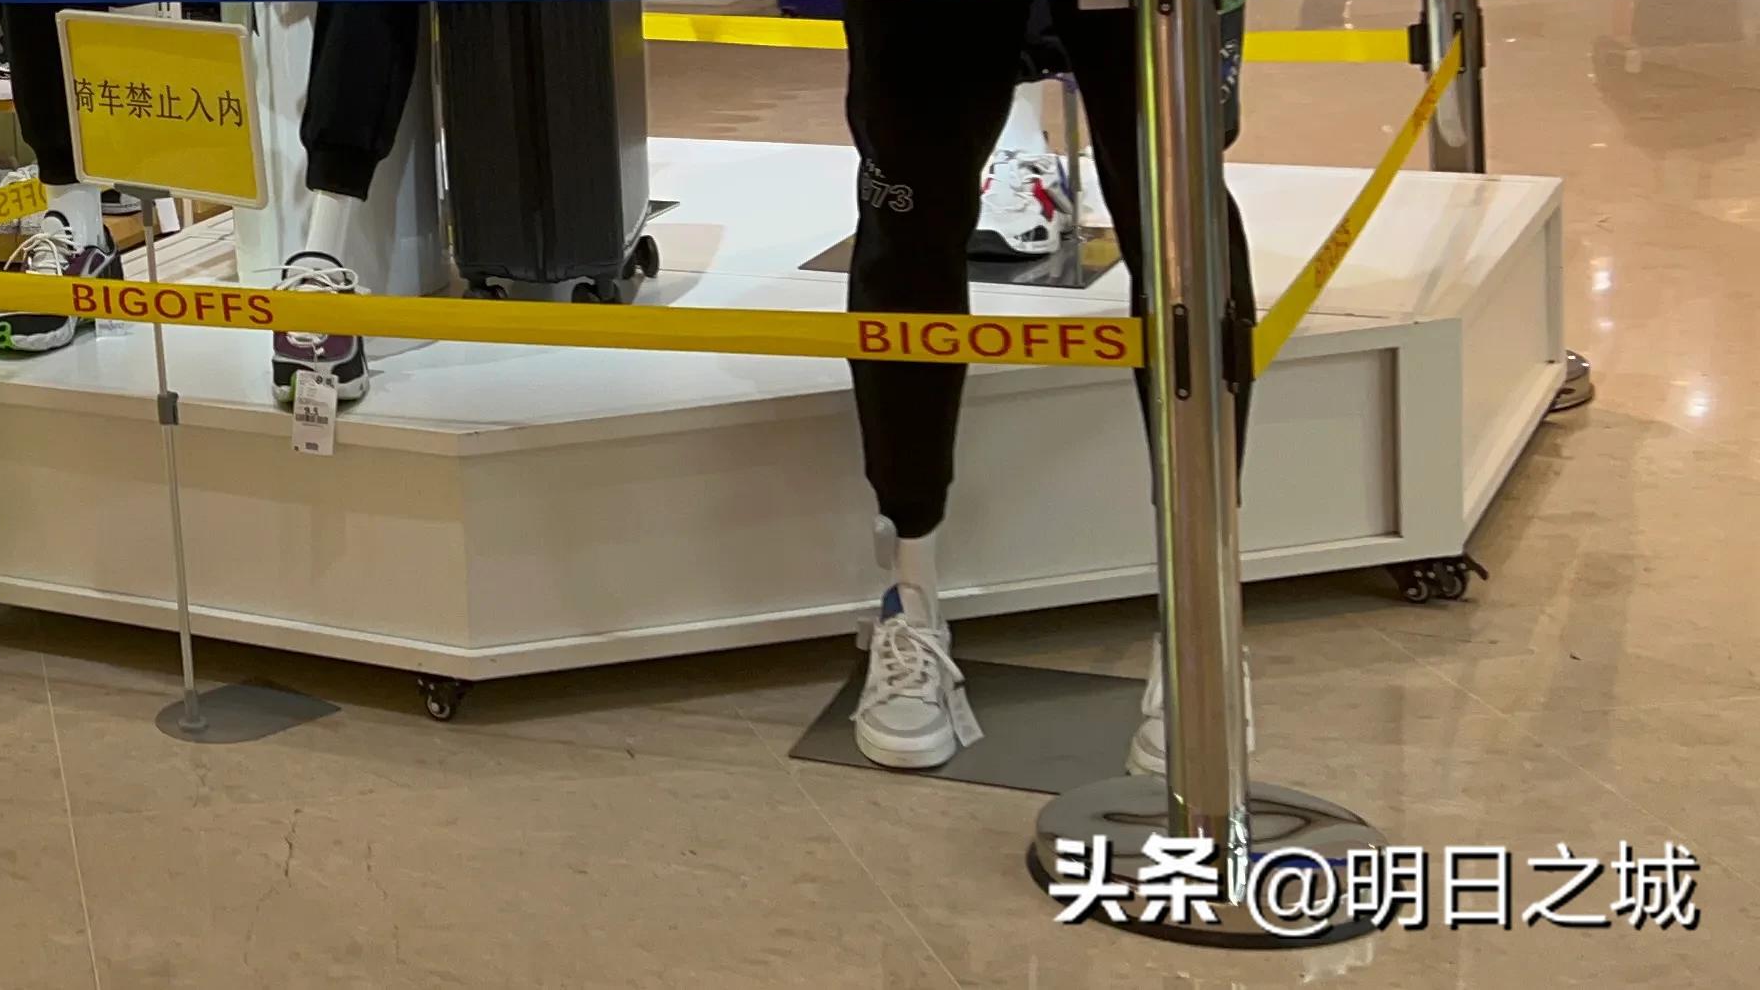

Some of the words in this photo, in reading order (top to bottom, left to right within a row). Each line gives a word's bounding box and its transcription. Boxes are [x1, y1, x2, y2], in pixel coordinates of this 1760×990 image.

[74, 78, 243, 127] 骑车禁止入内
[72, 283, 274, 325] BIGOFFS
[858, 320, 1127, 360] BIGOFFS
